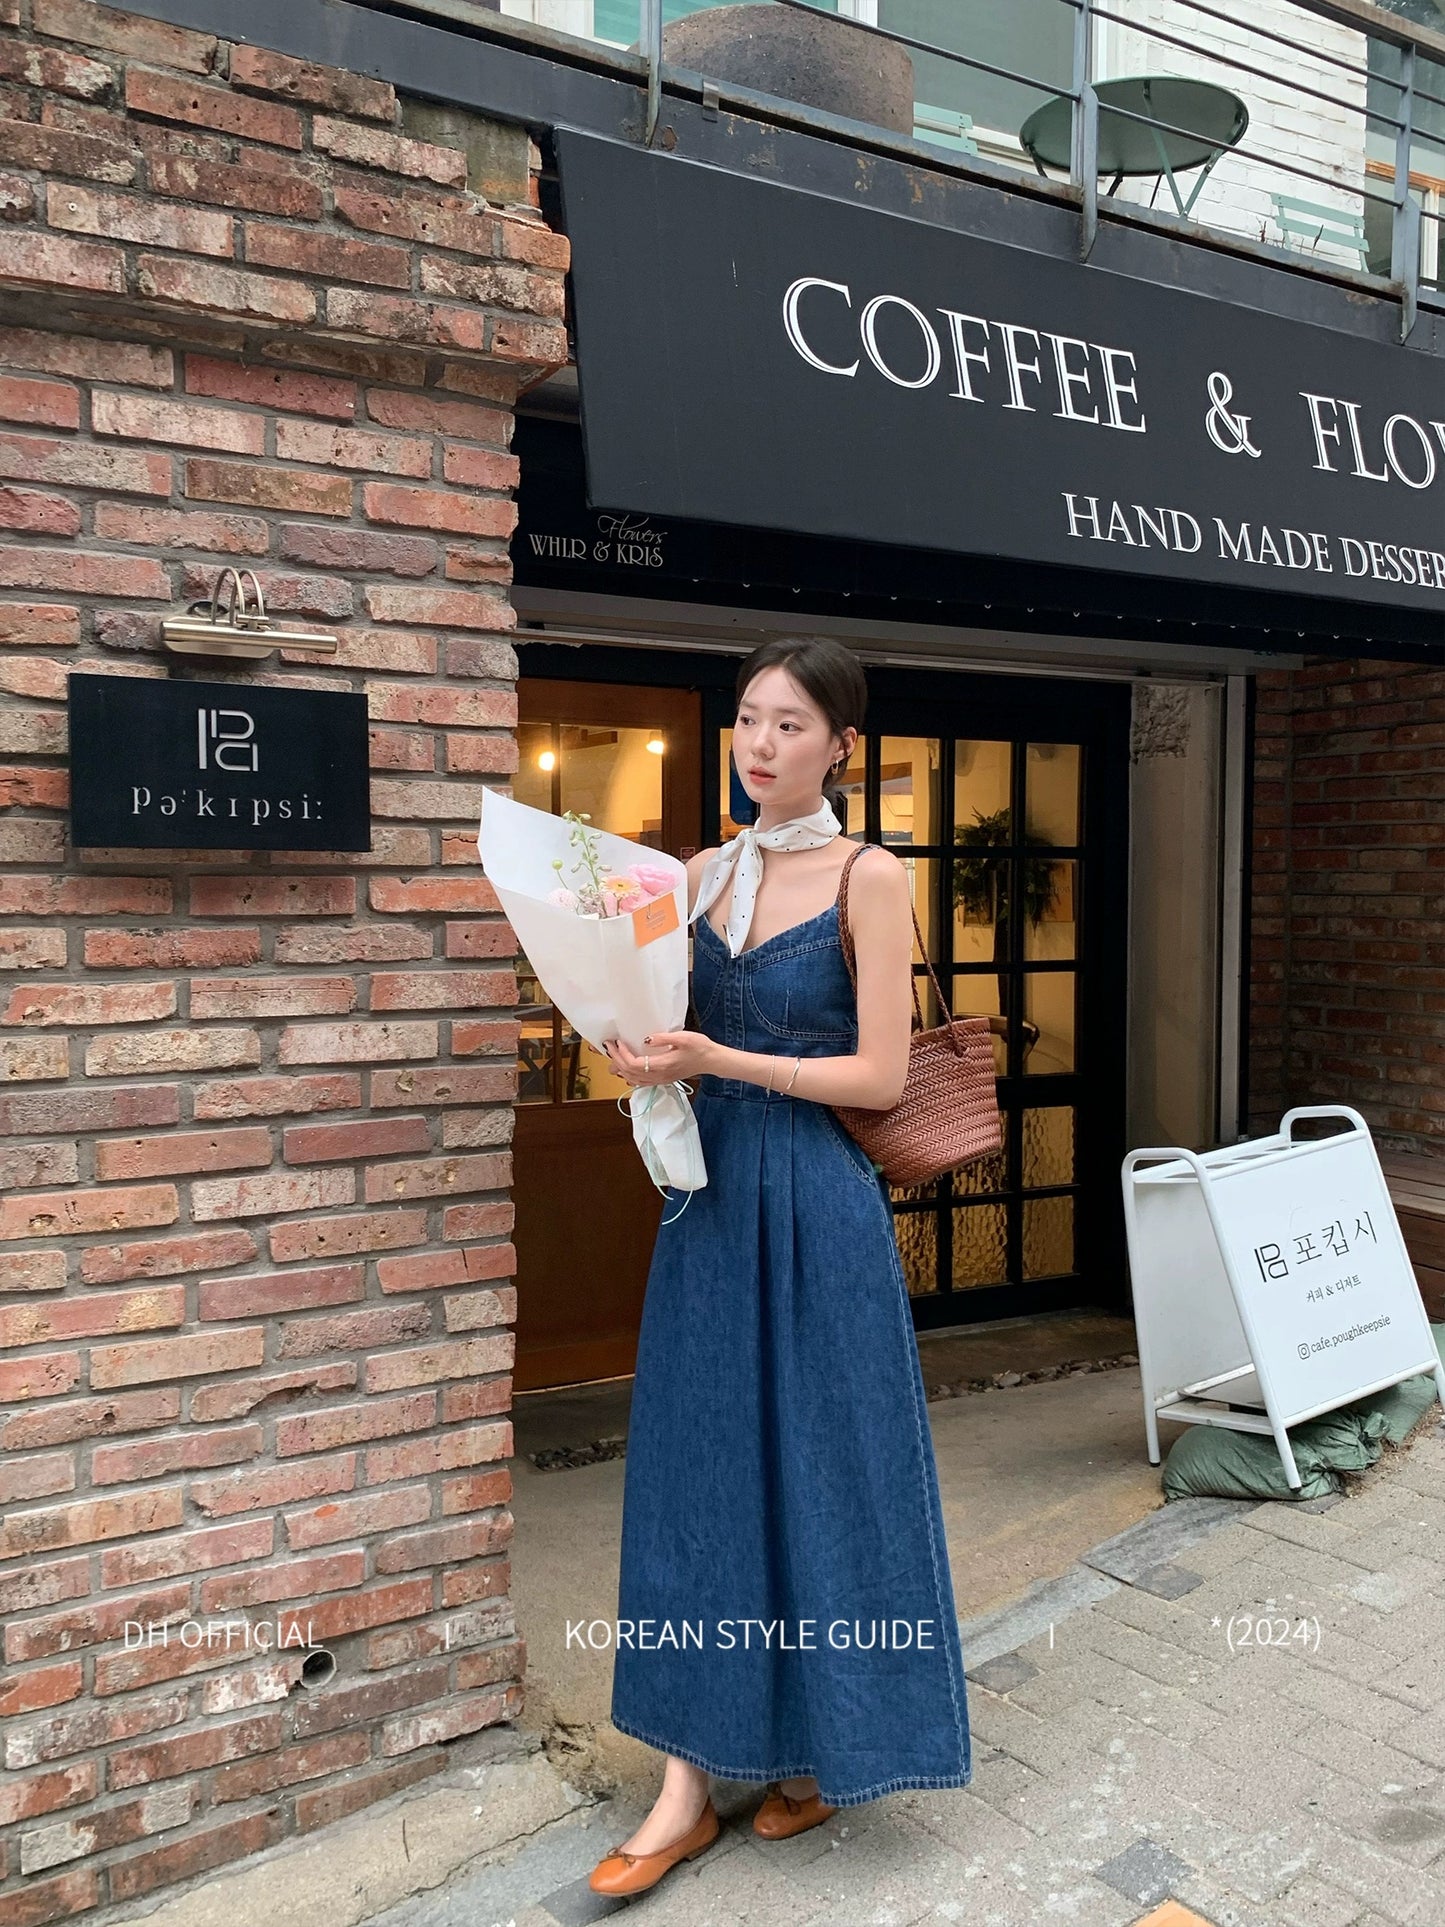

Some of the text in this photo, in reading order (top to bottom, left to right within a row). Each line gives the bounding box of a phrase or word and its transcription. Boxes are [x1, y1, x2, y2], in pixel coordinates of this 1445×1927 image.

[782, 276, 1445, 489] COFFEE & FLO
[597, 514, 669, 545] Flowers
[1060, 492, 1202, 553] HAND
[1211, 516, 1333, 573] MADE
[593, 541, 611, 562] &
[616, 543, 664, 568] KRIS
[1292, 1211, 1377, 1265] 포킵시
[1306, 1274, 1362, 1303] 커피 & 디저트
[1310, 1315, 1391, 1353] cafe.poughkeepsie
